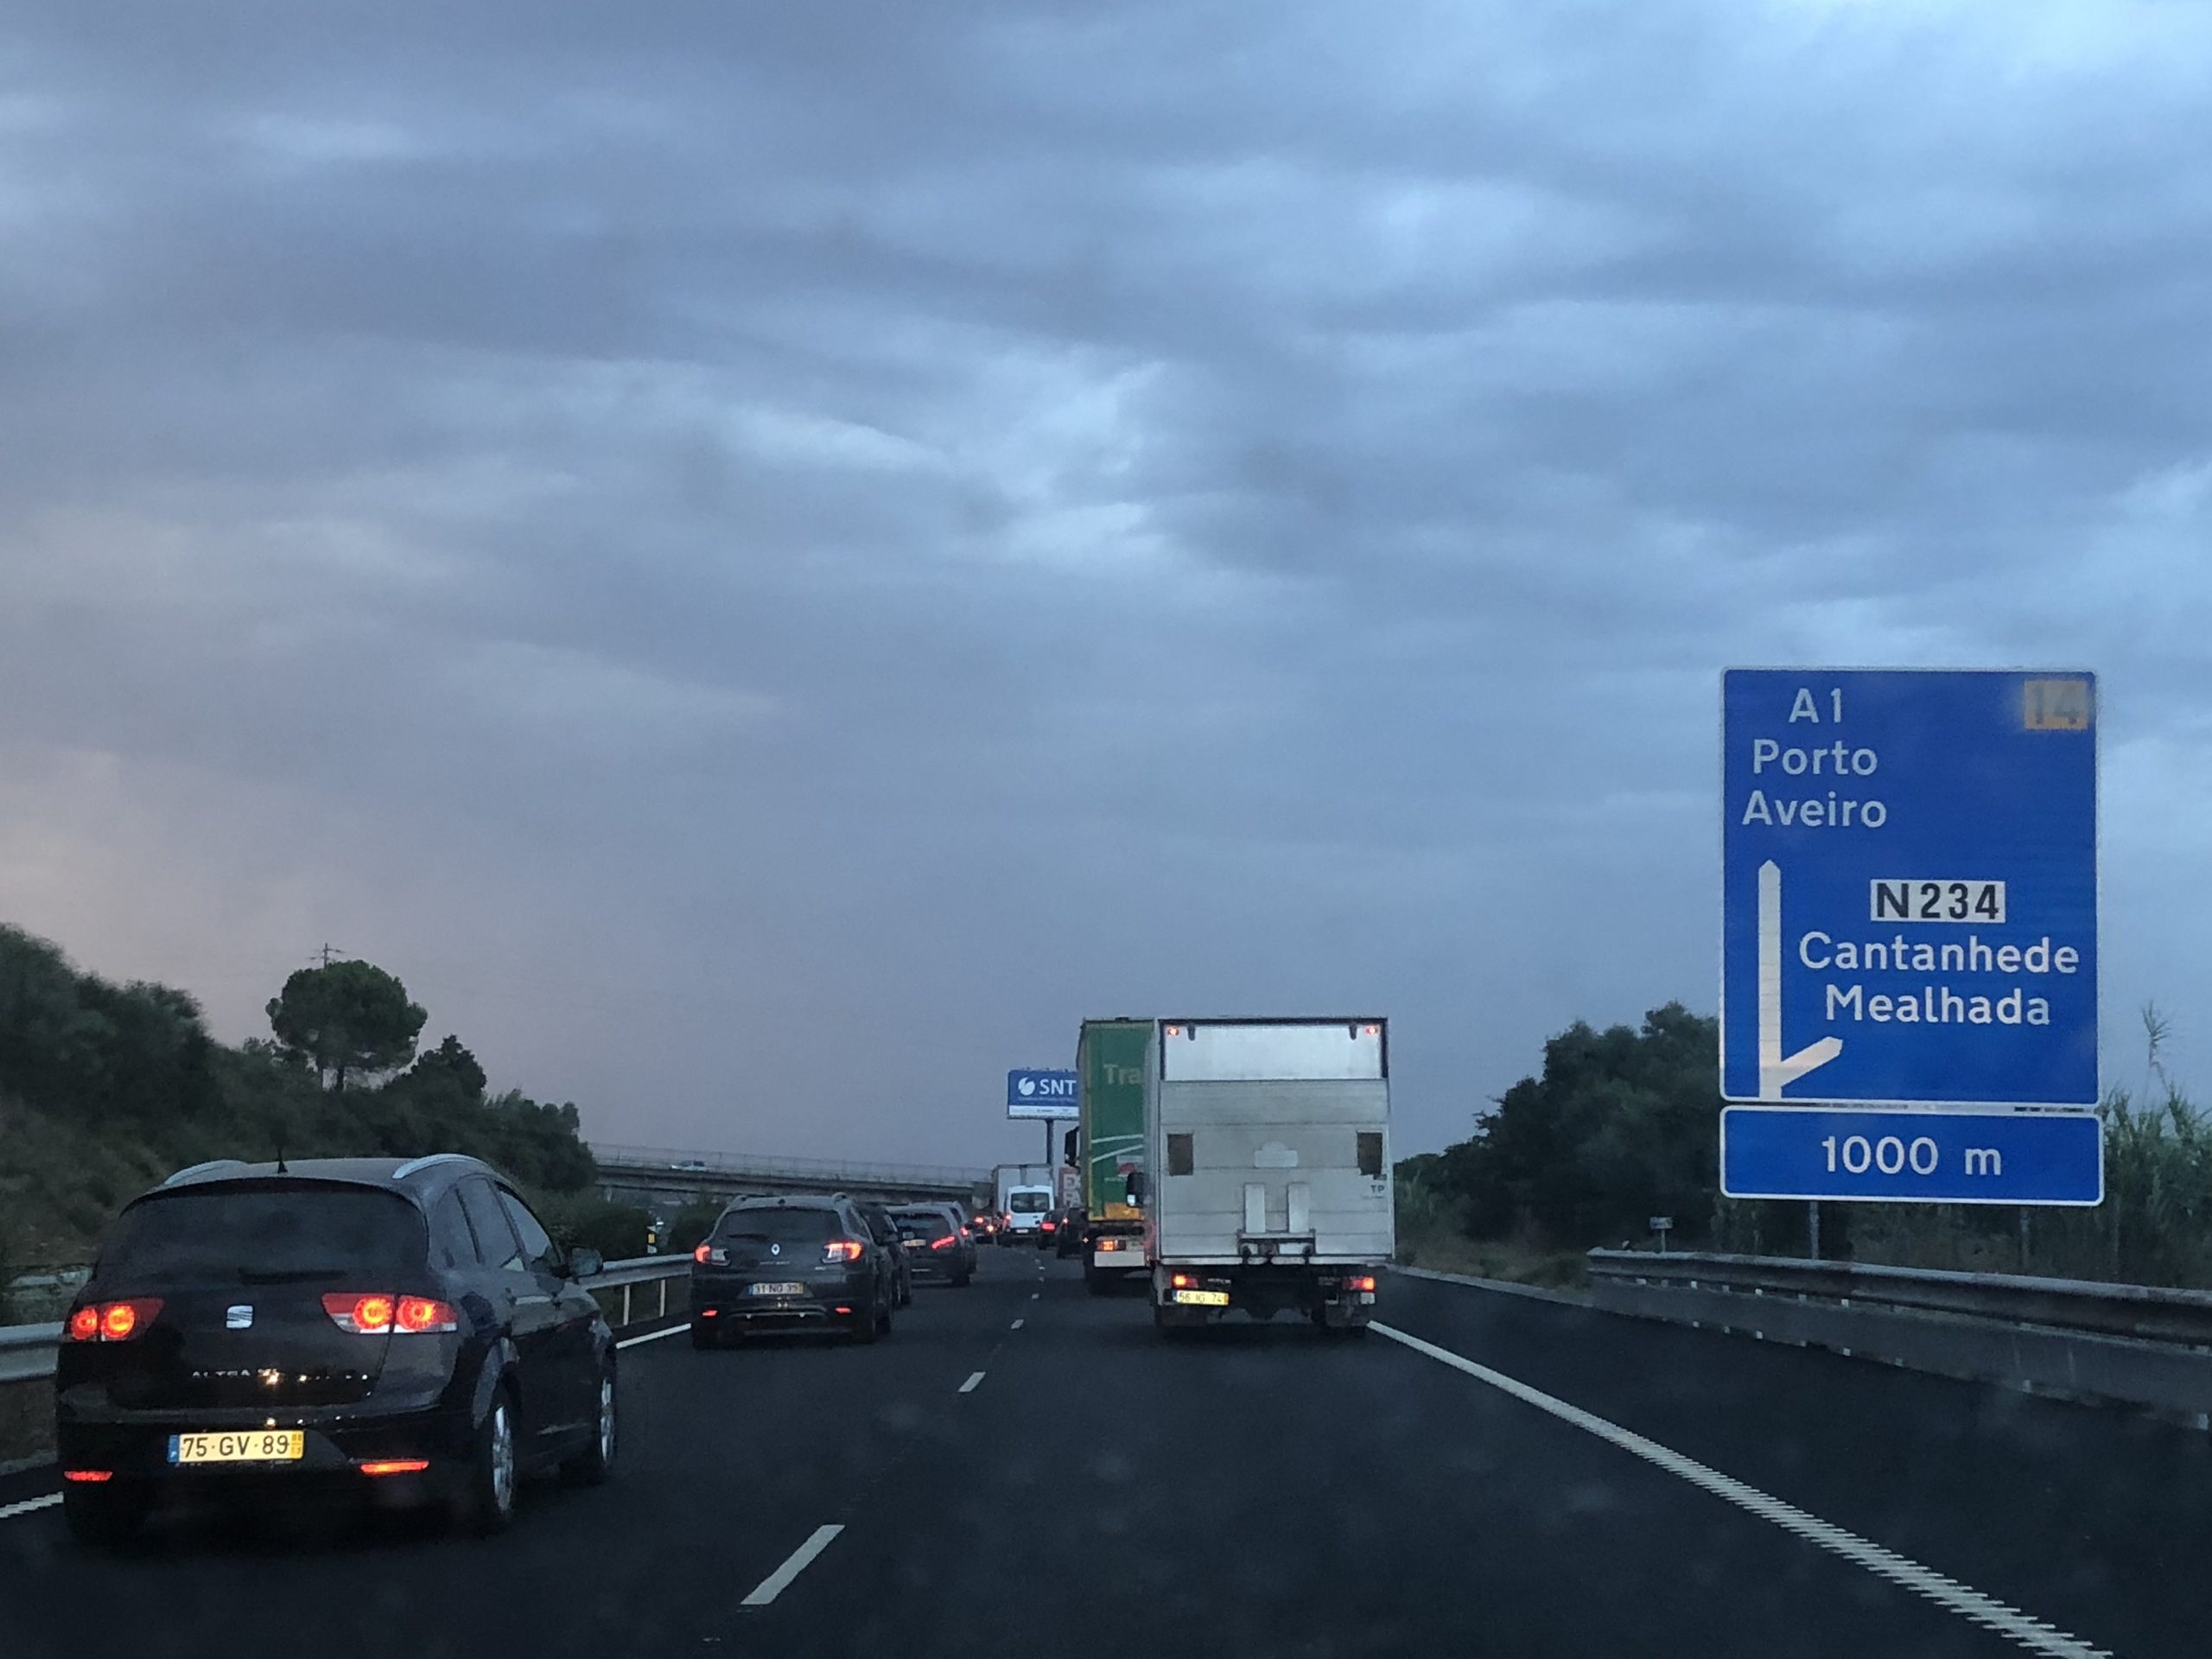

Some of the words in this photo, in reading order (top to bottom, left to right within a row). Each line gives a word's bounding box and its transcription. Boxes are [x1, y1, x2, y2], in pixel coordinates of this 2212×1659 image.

[1753, 739, 1878, 776] Porto
[1742, 791, 1887, 829] Aveiro
[1876, 882, 2000, 920] N234
[1799, 931, 2080, 975] Cantanhede
[1825, 984, 2050, 1026] Mealhada
[1039, 1078, 1077, 1096] SNT
[1821, 1135, 1939, 1176] 1000
[1964, 1148, 2002, 1176] m
